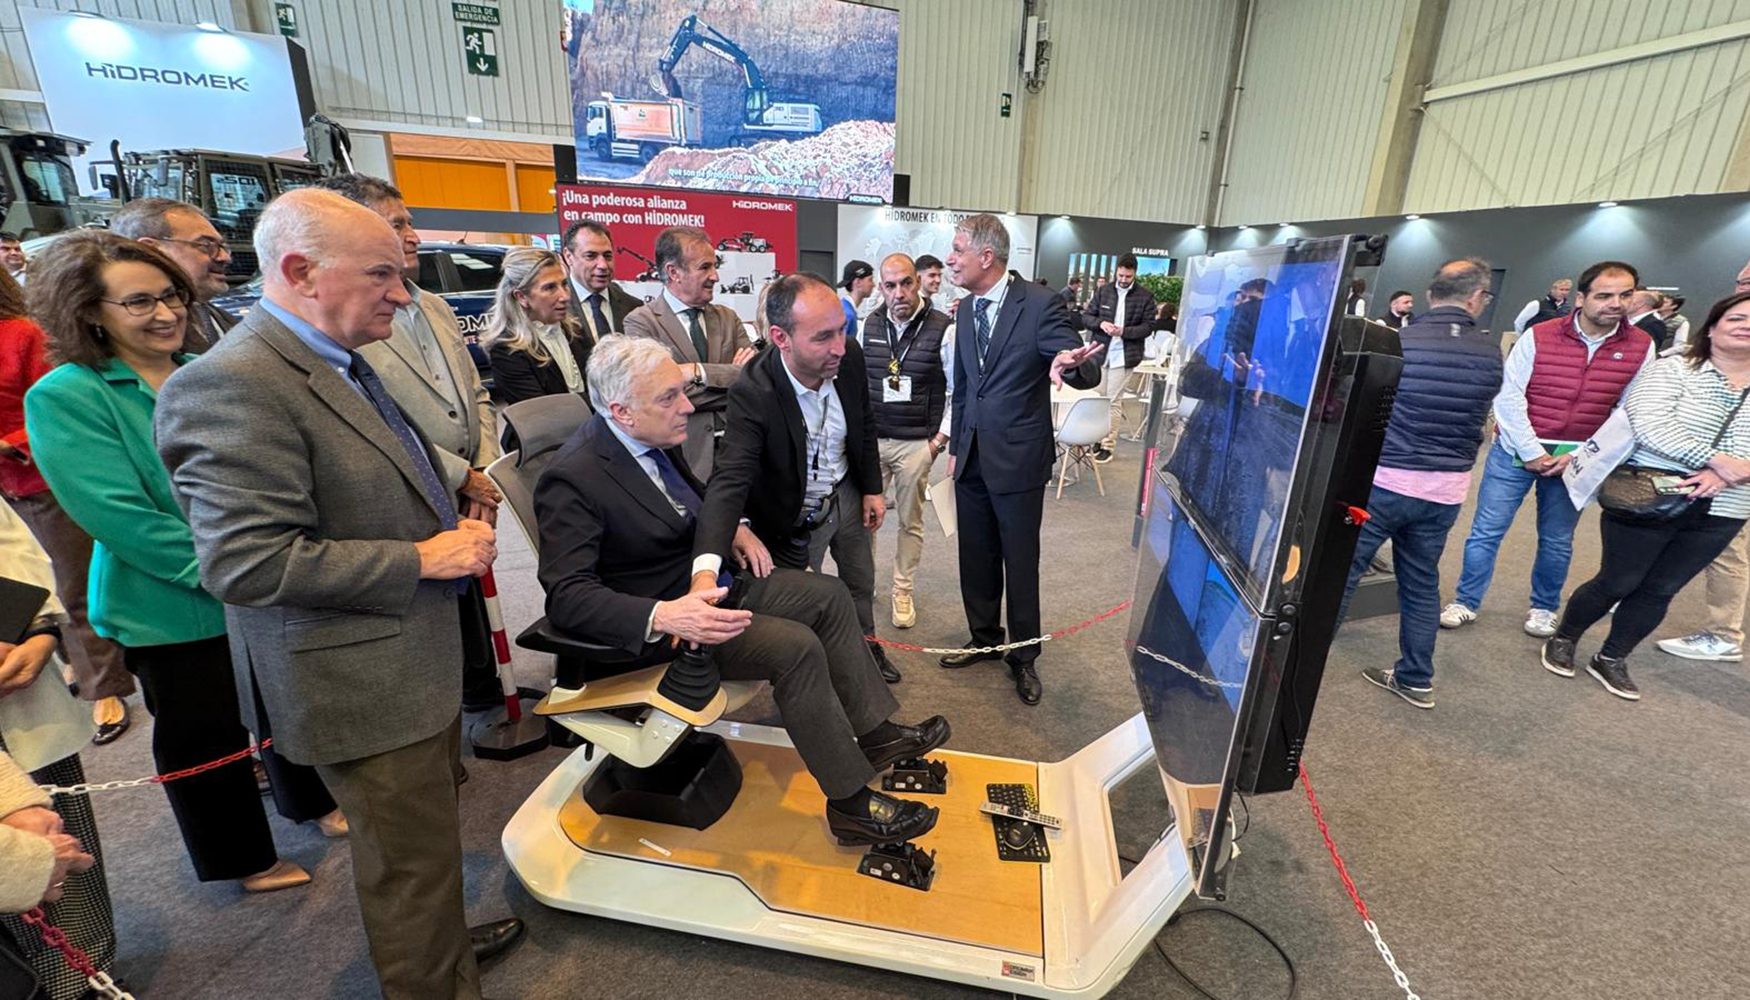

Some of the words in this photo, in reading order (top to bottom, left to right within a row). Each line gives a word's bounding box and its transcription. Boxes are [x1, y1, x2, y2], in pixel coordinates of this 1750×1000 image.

[458, 4, 482, 14] SALIDA
[484, 8, 493, 16] DE
[455, 11, 499, 23] EMERGENCIA
[562, 189, 590, 206] ¡Una
[592, 192, 645, 208] poderosa
[647, 195, 687, 210] alianza
[564, 210, 579, 220] en
[581, 211, 620, 226] campo
[622, 213, 642, 224] con
[1132, 247, 1147, 255] SALA
